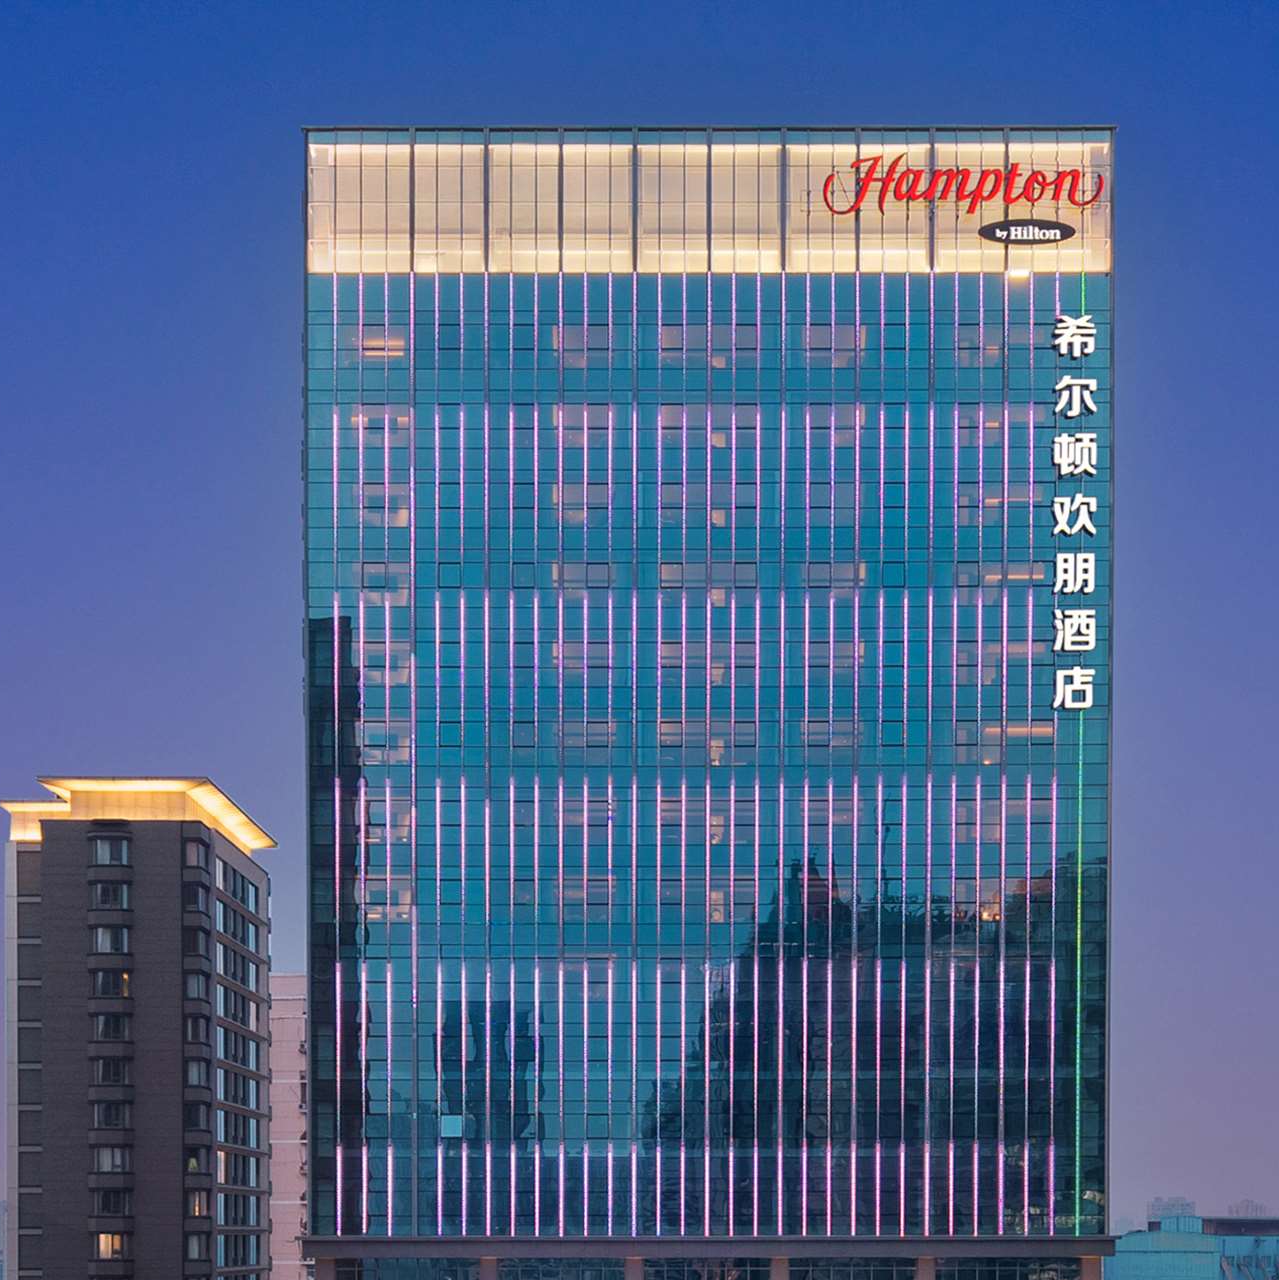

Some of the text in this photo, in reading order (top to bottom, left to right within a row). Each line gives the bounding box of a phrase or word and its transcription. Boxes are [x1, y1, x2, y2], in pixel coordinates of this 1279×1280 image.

[823, 152, 1104, 215] Hampton
[995, 225, 1061, 240] by Hilton
[1053, 314, 1097, 709] 希尔顿欢朋酒店
